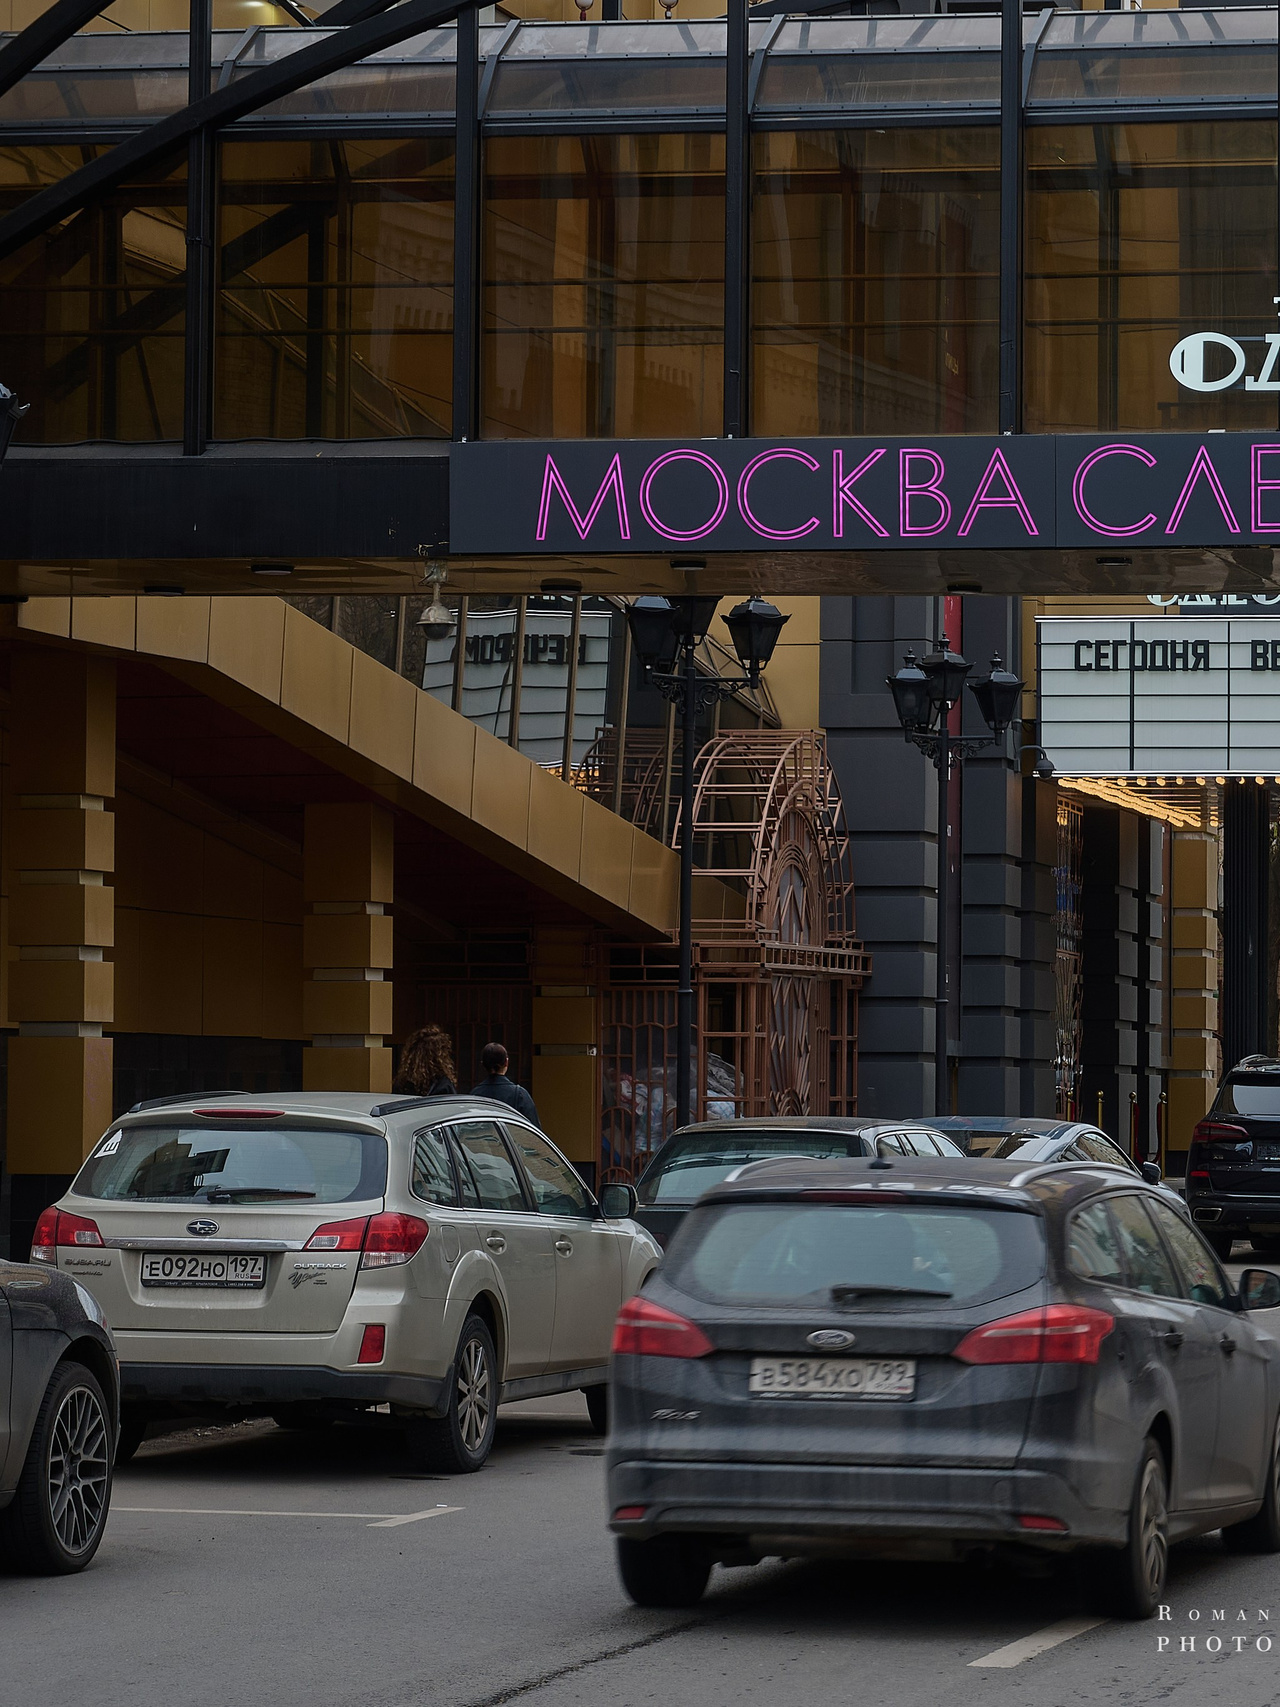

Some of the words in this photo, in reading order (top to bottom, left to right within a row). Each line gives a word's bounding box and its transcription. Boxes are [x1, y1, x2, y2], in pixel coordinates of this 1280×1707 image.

[535, 447, 1040, 542] МОСКВА
[1074, 640, 1210, 671] СЕГОДНЯ
[149, 1257, 225, 1278] Е092НО
[230, 1257, 259, 1273] 197
[293, 1262, 348, 1271] OUTBACK
